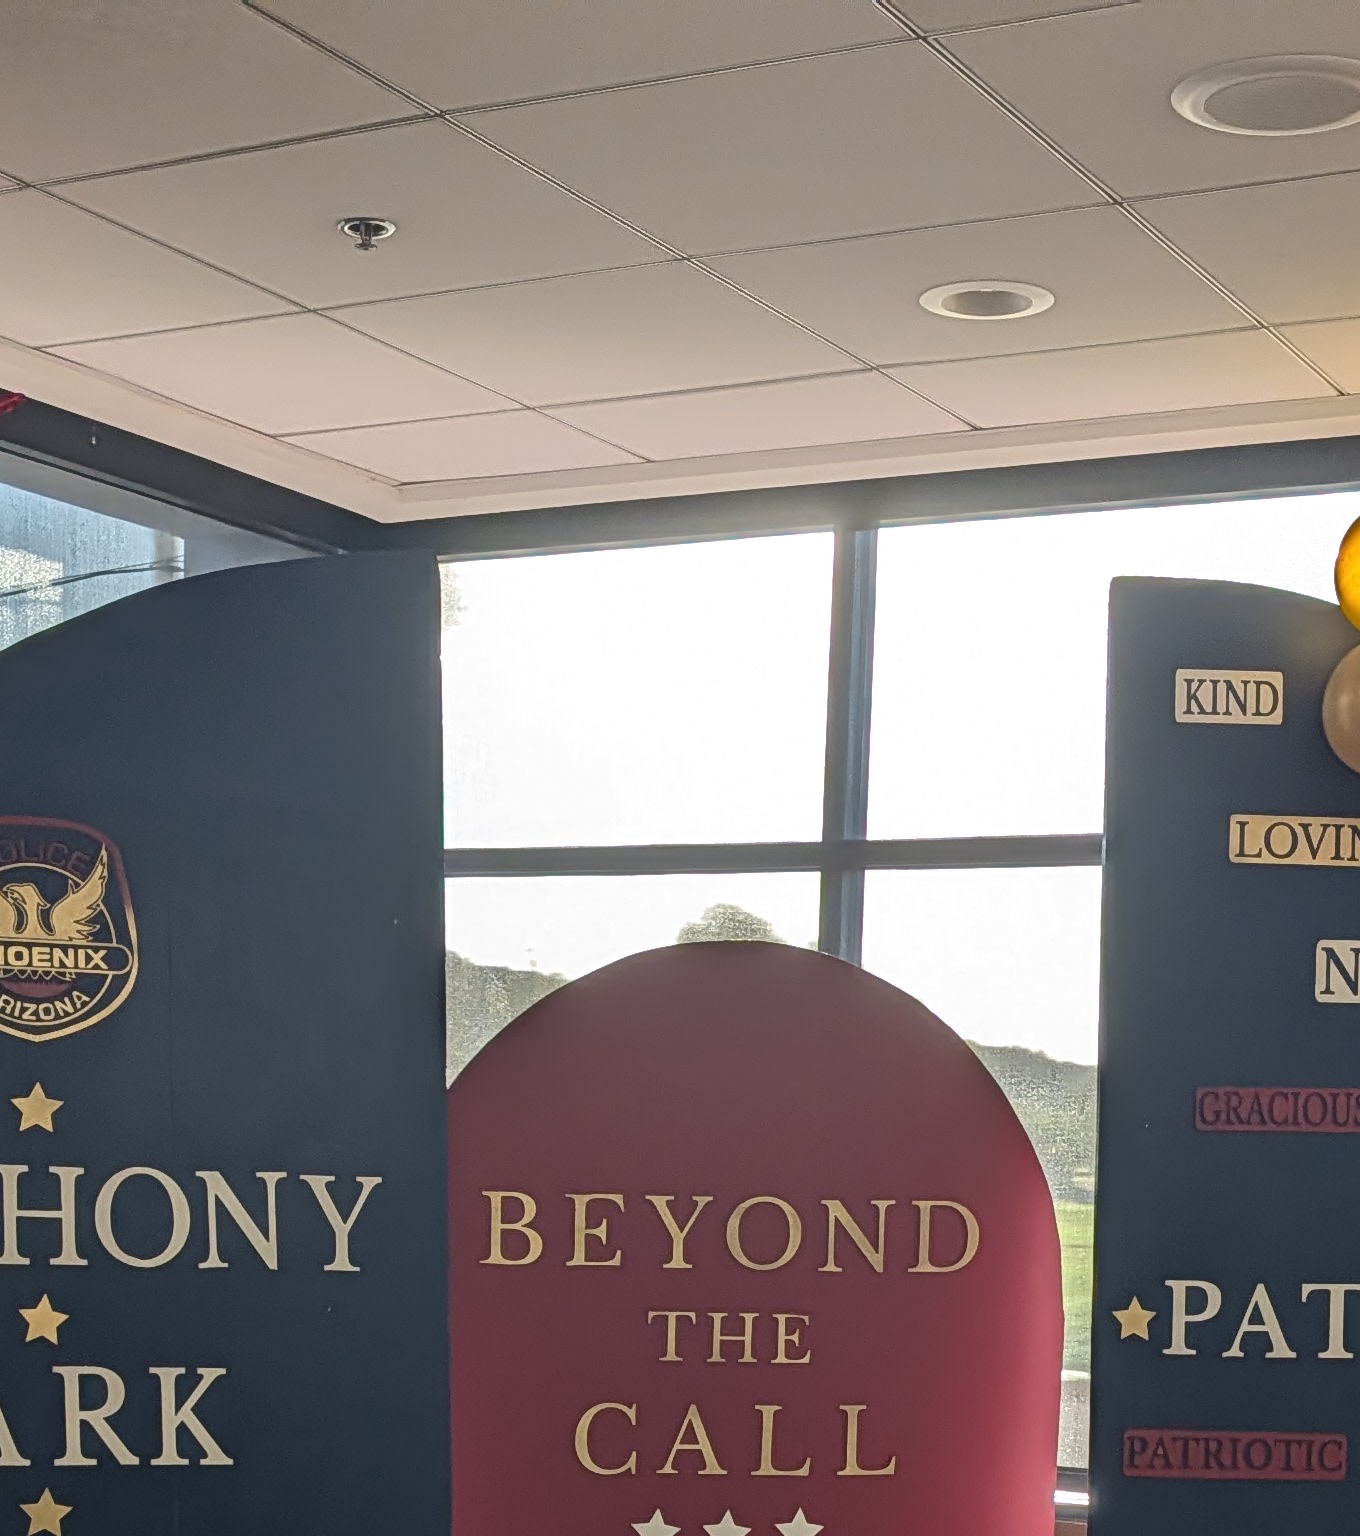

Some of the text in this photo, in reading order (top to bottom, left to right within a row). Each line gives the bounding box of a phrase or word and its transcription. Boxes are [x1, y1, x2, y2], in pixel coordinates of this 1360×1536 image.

[1183, 678, 1279, 716] KIND
[479, 1190, 980, 1273] BEYOND
[647, 1311, 811, 1363] THE
[574, 1402, 896, 1476] CALL
[1125, 1435, 1343, 1473] PATRIOTIC
